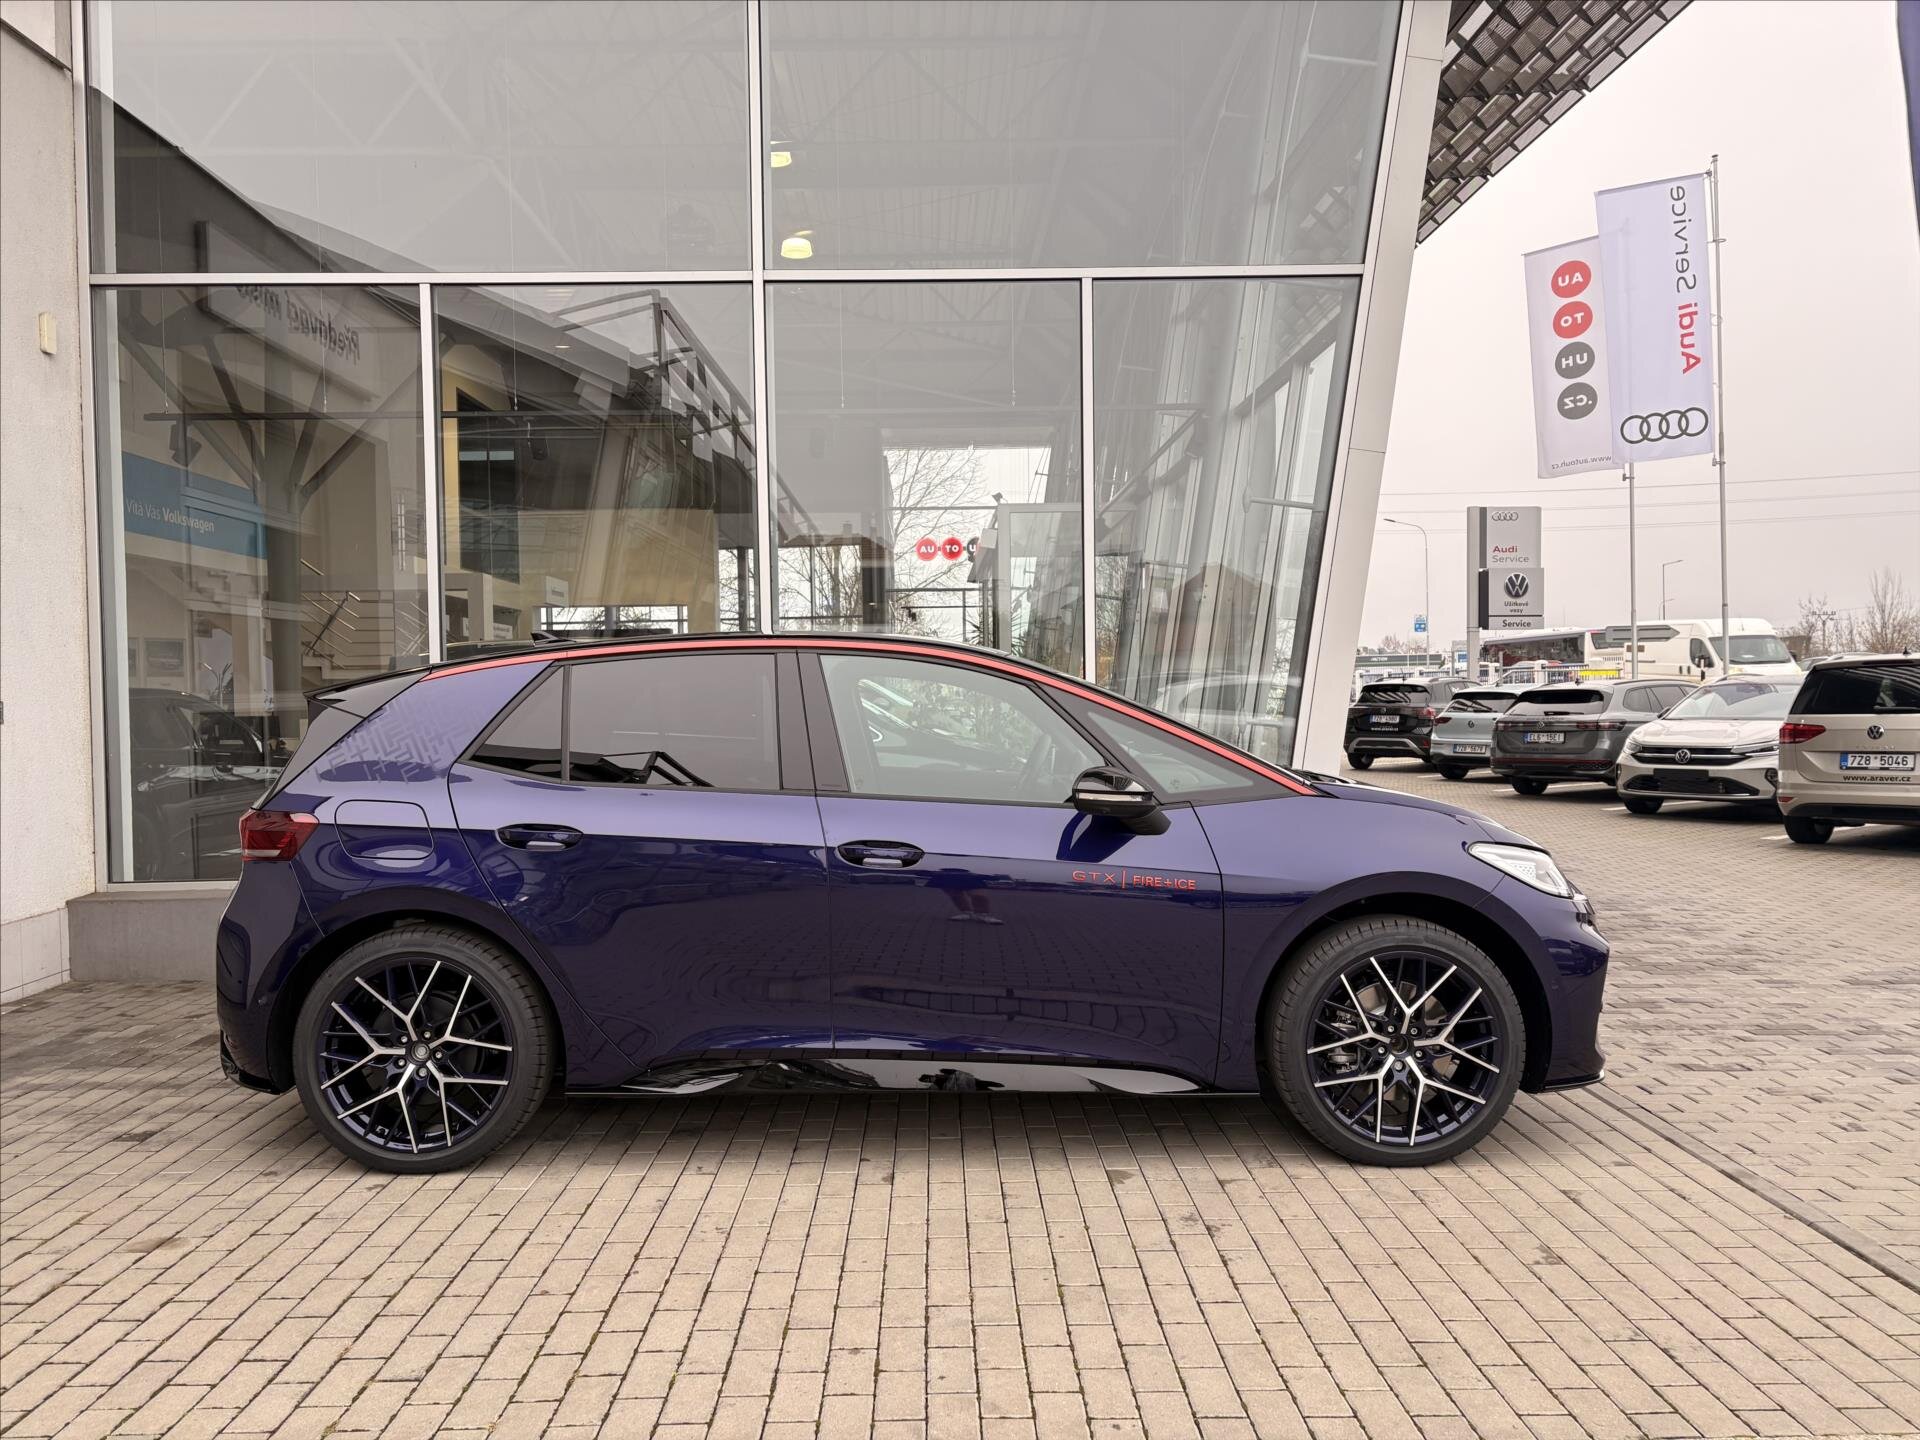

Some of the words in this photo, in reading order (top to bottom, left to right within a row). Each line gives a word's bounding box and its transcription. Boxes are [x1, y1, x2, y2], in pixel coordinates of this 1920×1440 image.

[162, 507, 215, 534] Volkswagen
[1492, 545, 1518, 553] Audi
[1492, 555, 1530, 563] Service
[1502, 619, 1532, 628] Service
[1850, 755, 1871, 766] 7Z8
[1880, 755, 1909, 766] 5046
[1072, 870, 1116, 884] GTX
[1133, 875, 1197, 891] FIRE+ICE
